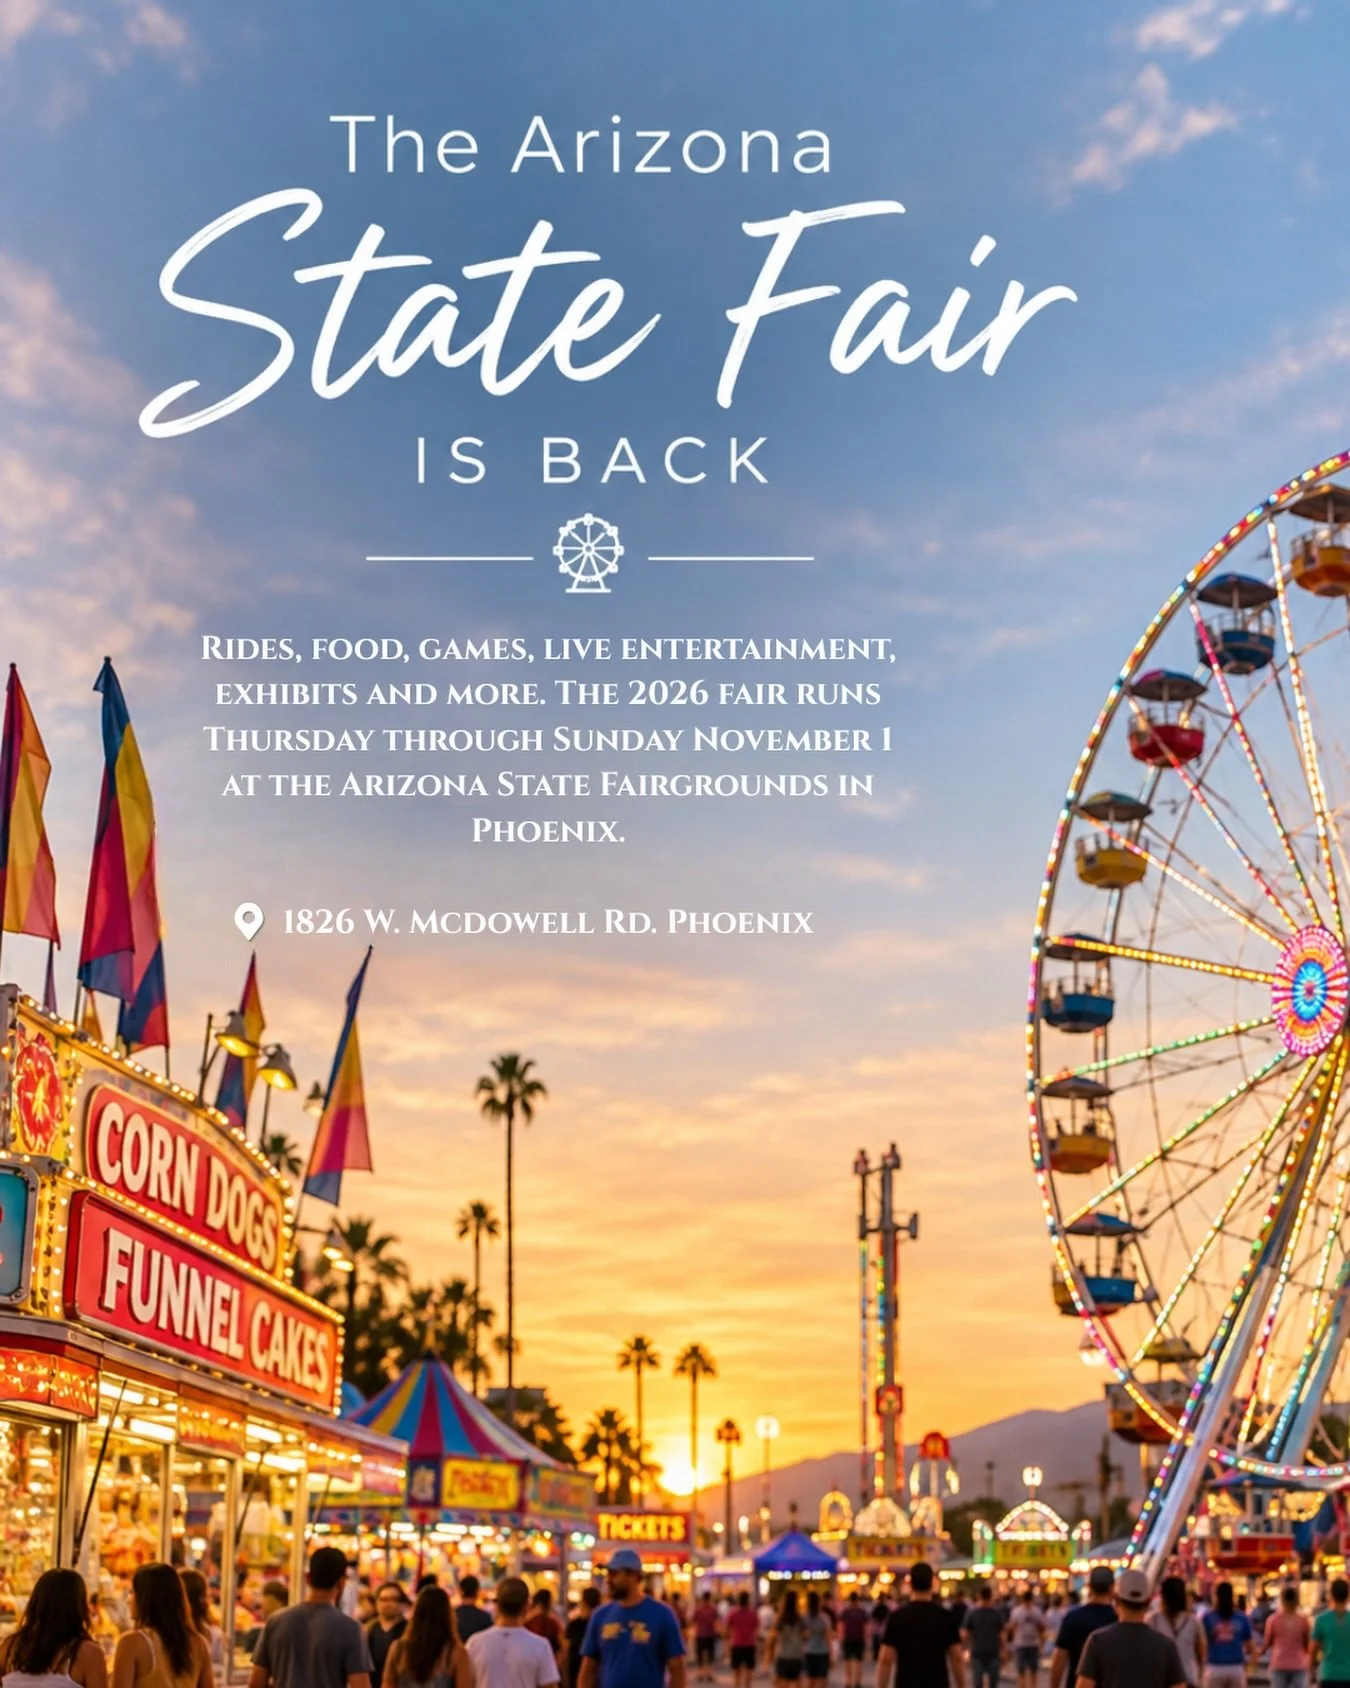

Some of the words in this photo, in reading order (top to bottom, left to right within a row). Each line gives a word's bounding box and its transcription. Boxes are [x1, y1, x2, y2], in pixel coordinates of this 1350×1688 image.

[98, 1101, 199, 1217] CORN
[206, 1156, 279, 1271] DOGS
[102, 1227, 245, 1360] FUNNEL
[250, 1300, 329, 1394] CAKES
[598, 1513, 686, 1541] TICKETS
